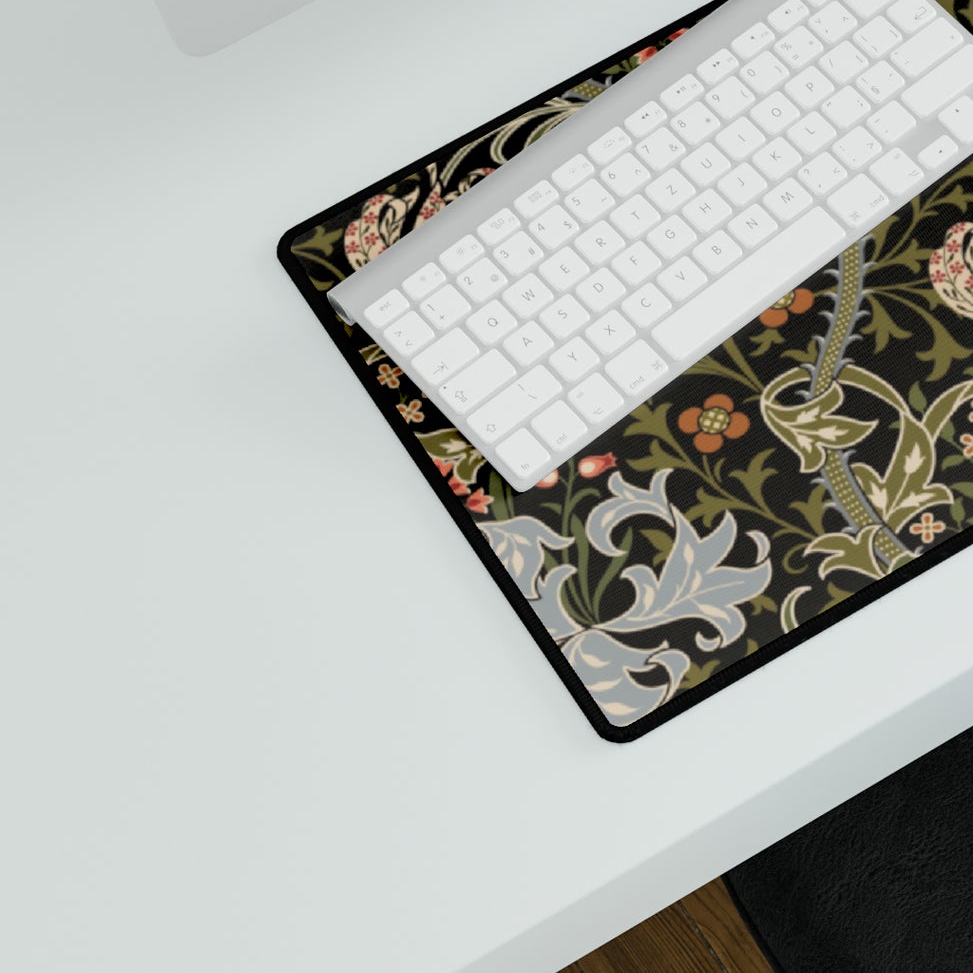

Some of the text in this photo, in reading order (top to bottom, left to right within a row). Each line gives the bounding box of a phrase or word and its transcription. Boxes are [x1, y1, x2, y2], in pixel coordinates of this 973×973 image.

[464, 275, 475, 285] 2
[500, 249, 510, 258] 3
[538, 222, 546, 231] 4
[571, 195, 582, 206] 5
[677, 119, 687, 128] 8
[487, 317, 500, 327] Q
[521, 288, 536, 301] W
[560, 263, 571, 274] E
[595, 237, 607, 247] R
[631, 210, 641, 219] T
[666, 184, 678, 195] Z
[700, 157, 713, 169] U
[805, 82, 814, 91] P
[522, 126, 817, 347] A S D F G H J K L
[567, 350, 578, 361] Y
[603, 324, 617, 336] X
[641, 297, 652, 307] C
[675, 270, 686, 280] V
[711, 245, 723, 255] B
[746, 217, 759, 229] N
[781, 191, 795, 203] M
